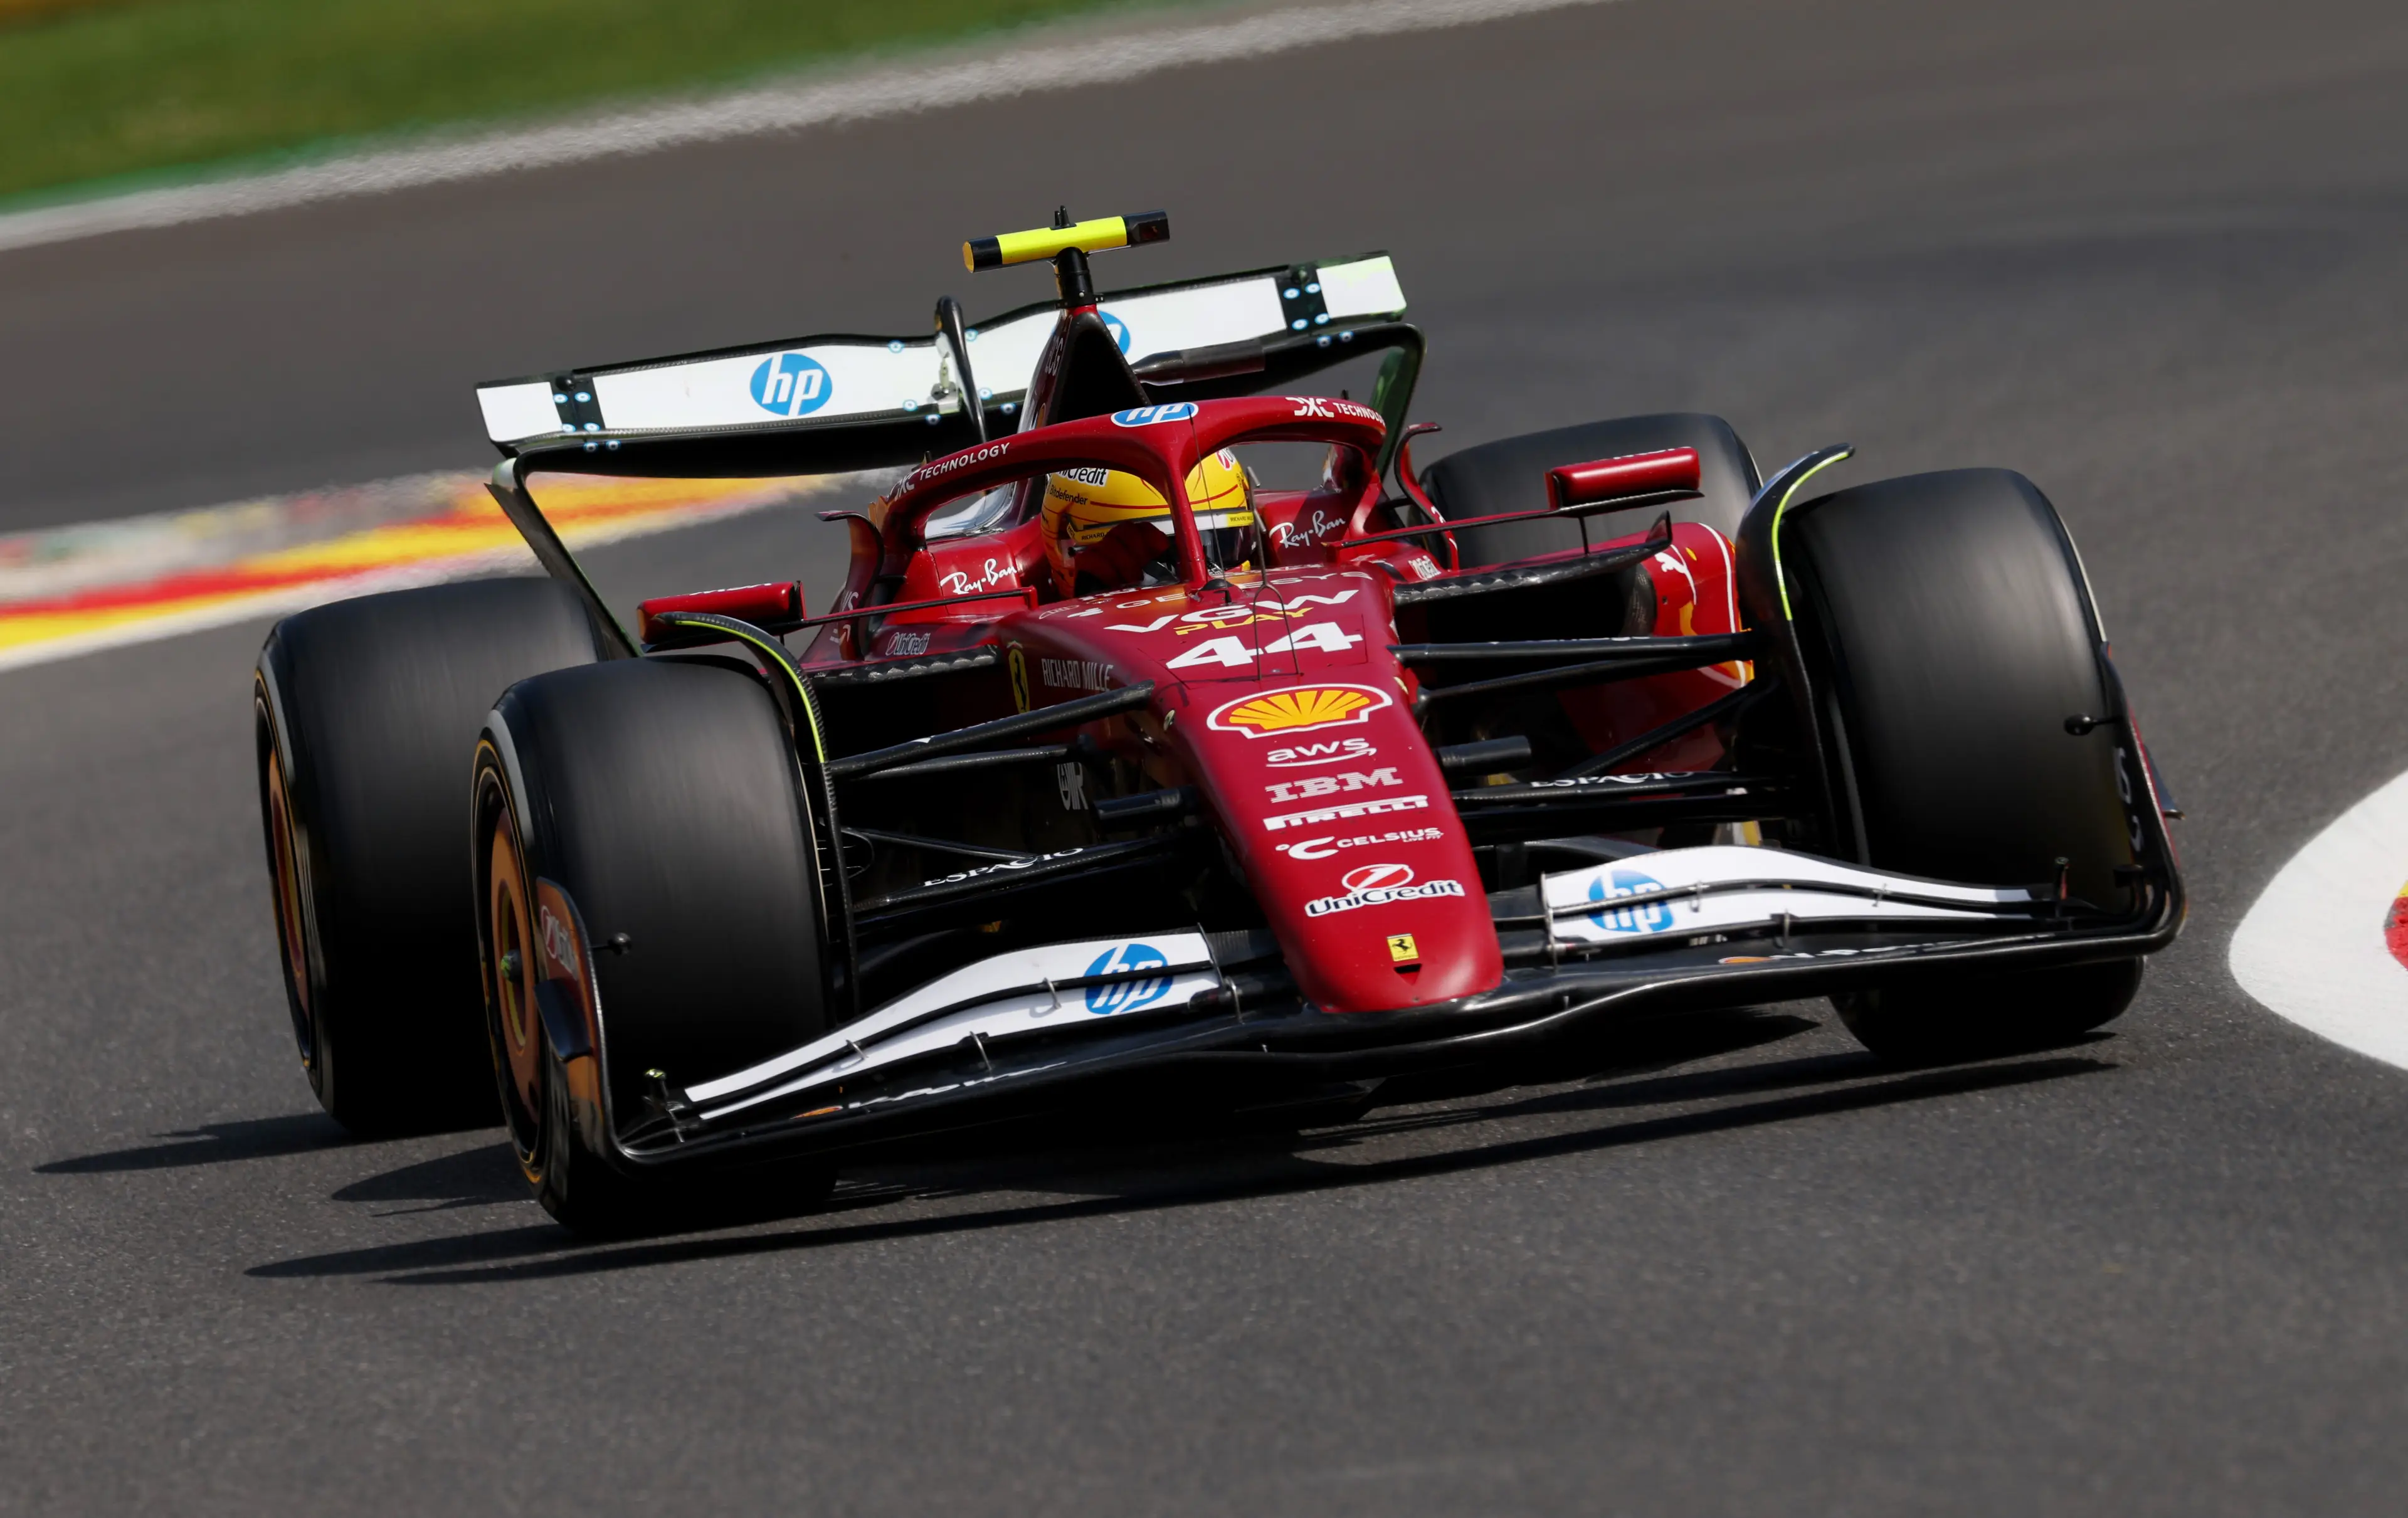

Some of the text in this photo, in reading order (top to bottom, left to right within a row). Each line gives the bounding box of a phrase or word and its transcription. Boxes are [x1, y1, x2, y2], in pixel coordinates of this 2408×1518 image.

[761, 353, 823, 416] hp
[919, 442, 1011, 481] TECHNOLOGY
[1050, 484, 1089, 505] Bitdefender
[1081, 531, 1105, 540] RICHARD
[1269, 510, 1346, 549] Ray-Ban
[939, 557, 1017, 595] Ray-Ban
[1103, 589, 1360, 633] VGW
[1173, 607, 1314, 636] PLAY
[1165, 621, 1364, 670] 44
[1041, 657, 1114, 691] RICHARD MILLE
[1266, 737, 1370, 763] aws
[1264, 767, 1404, 803] IBM
[1263, 794, 1429, 831] PIRELLI
[1336, 827, 1442, 848] CELSIUS
[1308, 881, 1460, 915] UniCredit
